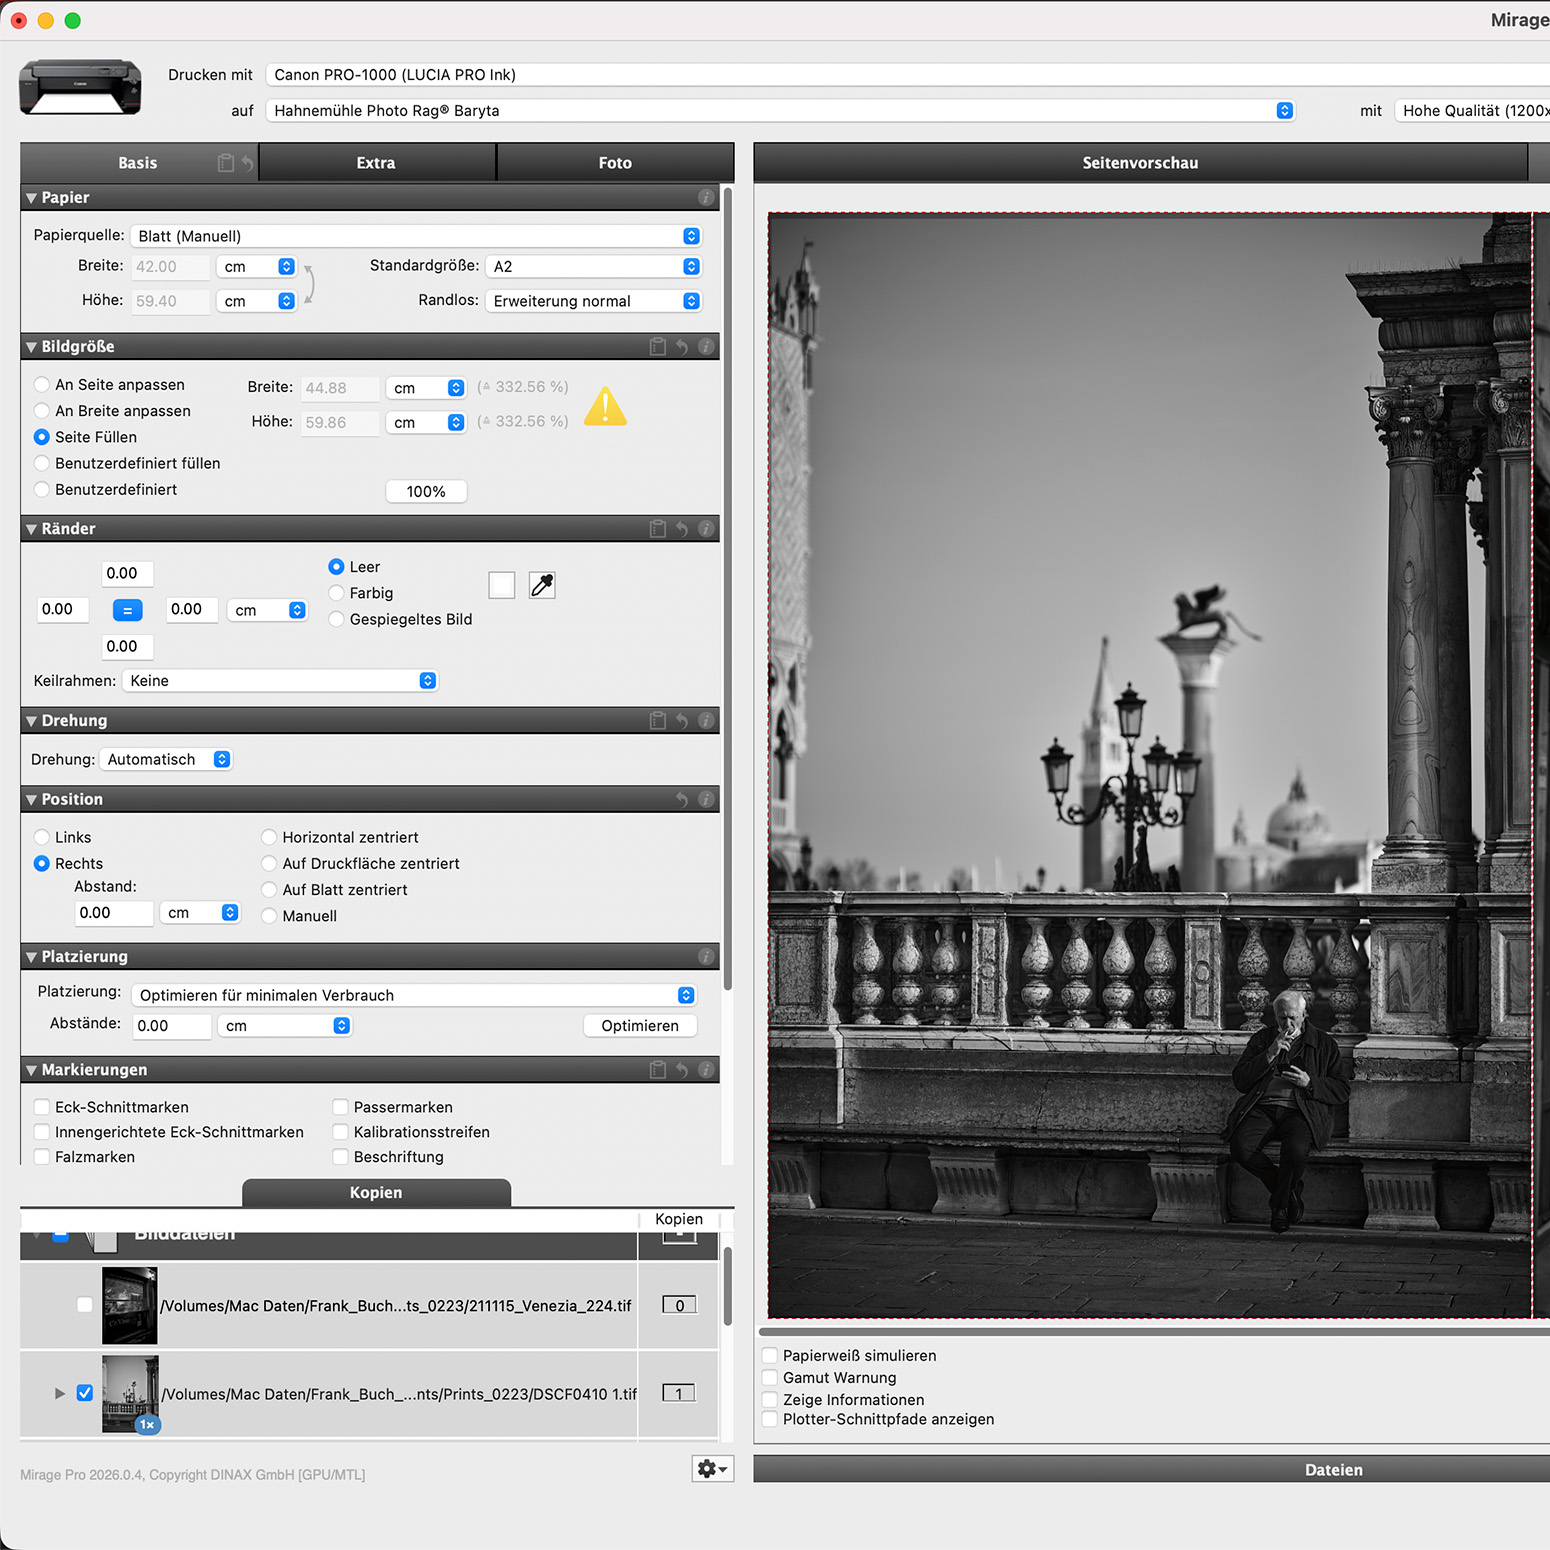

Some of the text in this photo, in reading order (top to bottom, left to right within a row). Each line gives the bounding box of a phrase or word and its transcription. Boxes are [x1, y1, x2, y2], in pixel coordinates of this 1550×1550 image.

[1491, 11, 1550, 31] Mirage
[168, 67, 254, 81] Drucken mit
[274, 67, 516, 84] Canon PRO-1000 (LUCIA PRO Ink)
[231, 103, 255, 117] auf
[275, 103, 363, 117] Hahnemühle
[367, 103, 409, 117] Photo
[454, 104, 500, 120] Baryta
[1360, 103, 1383, 117] mit
[1403, 103, 1441, 117] Hohe
[1444, 103, 1500, 118] Qualität
[118, 155, 158, 170] Basis
[356, 156, 397, 170] Extra
[599, 156, 633, 170] Foto
[1082, 155, 1199, 170] Seitenvorschau
[42, 190, 91, 207] Papier
[34, 228, 125, 244] Papierquelle:
[139, 229, 241, 246] Blatt (Manuell)
[78, 258, 124, 272] Breite:
[135, 260, 177, 273] 42.00
[224, 262, 246, 273] cm
[370, 258, 480, 275] Standardgröße:
[493, 260, 513, 273] A2
[82, 292, 123, 306] Höhe:
[136, 294, 177, 308] 59.40
[224, 297, 246, 308] cm
[418, 292, 479, 306] Randlos:
[494, 294, 631, 310] Erweiterung normal
[42, 338, 115, 356] Bildgröße
[55, 377, 185, 394] An Seite anpassen
[305, 381, 347, 395] 44.88
[495, 380, 546, 393] 332.56
[55, 430, 137, 444] Seite Füllen
[55, 456, 221, 470] Benutzerdefiniert füllen
[406, 485, 446, 498] 100%
[42, 521, 97, 536] Ränder
[106, 566, 138, 580] 0.00
[350, 560, 381, 573] Leer
[350, 586, 394, 602] Farbig
[41, 602, 73, 616] 0.00
[349, 612, 473, 629] Gespiegeltes Bild
[34, 673, 116, 687] Keilrahmen:
[131, 673, 169, 687] Keine
[42, 713, 108, 730] Drehung
[31, 752, 95, 769] Drehung:
[107, 752, 196, 766] Automatisch
[42, 792, 103, 806] Position
[55, 830, 92, 844] Links
[283, 830, 419, 844] Horizontal zentriert
[55, 856, 104, 870] Rechts
[282, 856, 460, 870] Auf Druckfläche zentriert
[73, 879, 137, 893] Abstand:
[283, 909, 337, 923] Manuell
[42, 949, 128, 966] Platzierung
[38, 984, 121, 1001] Platzierung:
[140, 988, 394, 1005] Optimieren für minimalen Verbrauch
[49, 1016, 121, 1030] Abstände:
[601, 1018, 679, 1035] Optimieren
[42, 1062, 148, 1080] Markierungen
[55, 1125, 304, 1141] Innengerichtete Eck-Schnittmarken
[354, 1149, 444, 1166] Beschriftung
[350, 1185, 403, 1202] Kopien
[655, 1212, 703, 1228] Kopien
[159, 1299, 259, 1315] /Volumes/Mac
[783, 1348, 937, 1365] Papierweiß simulieren
[783, 1371, 897, 1387] Gamut Warnung
[161, 1387, 261, 1404] /Volumes/Mac
[611, 1387, 638, 1401] 1.tif
[783, 1392, 925, 1409] Zeige Informationen
[783, 1412, 995, 1428] Plotter-Schnittpfade anzeigen
[20, 1468, 62, 1484] Mirage
[65, 1468, 87, 1481] Pro
[89, 1468, 146, 1483] 2026.0.4,
[149, 1468, 208, 1484] Copyright
[255, 1468, 295, 1481] GmbH
[298, 1468, 366, 1484] [GPU/MTL]
[1305, 1463, 1363, 1477] Dateien
